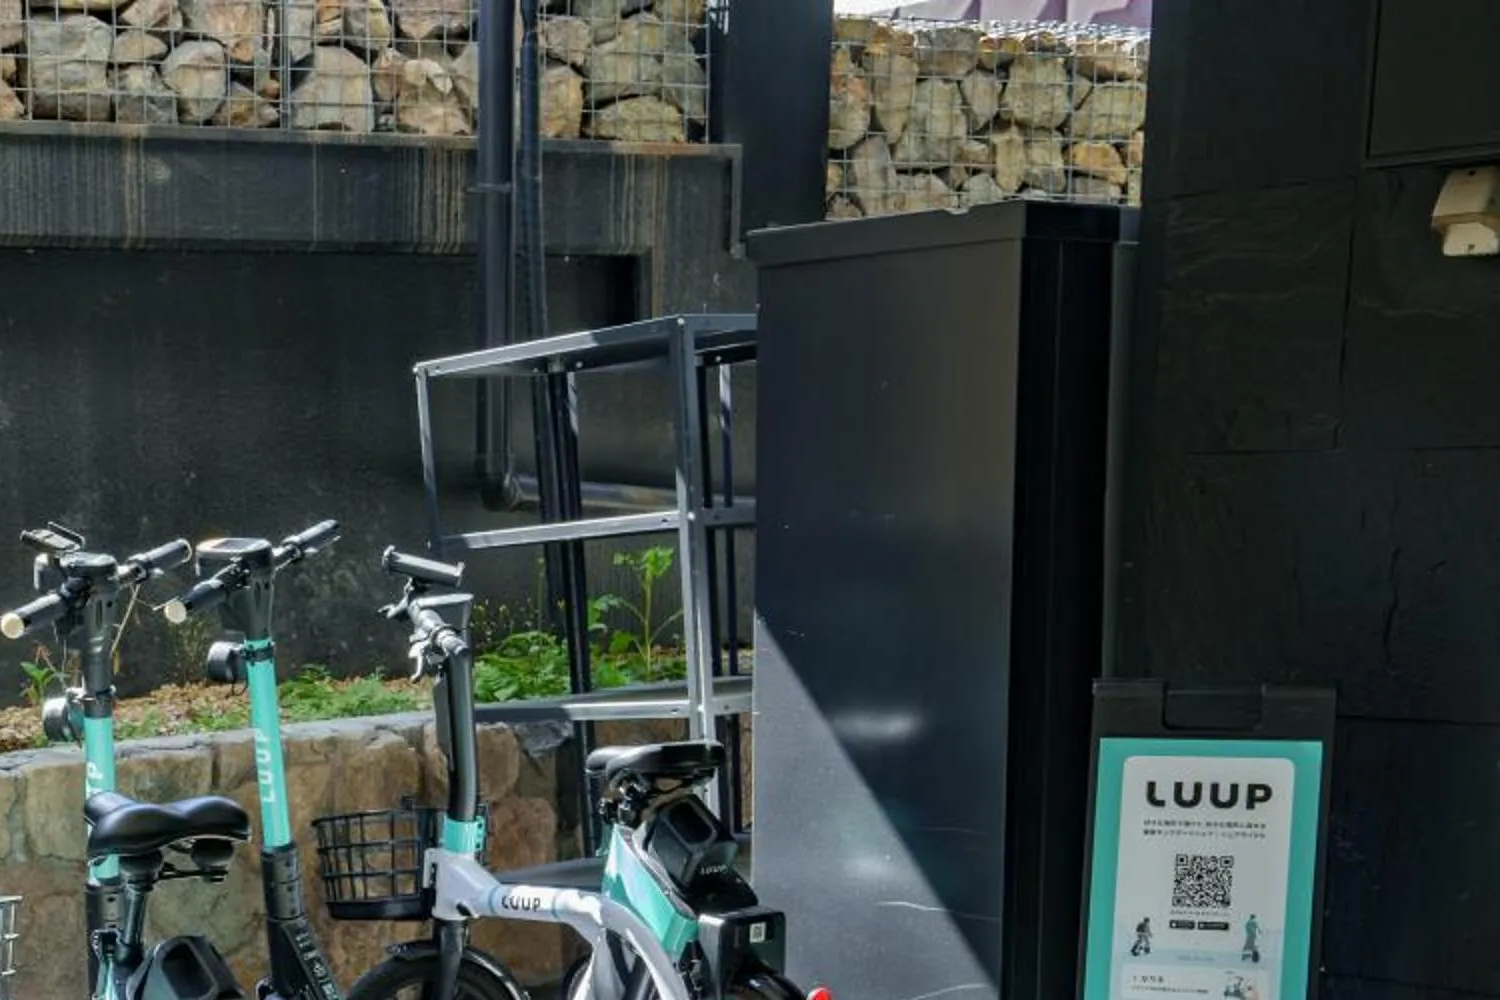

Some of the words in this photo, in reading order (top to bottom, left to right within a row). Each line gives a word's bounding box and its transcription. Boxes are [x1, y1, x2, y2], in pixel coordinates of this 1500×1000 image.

[255, 728, 277, 803] LUUP
[1145, 781, 1273, 810] LUUP
[501, 895, 541, 912] LUUP
